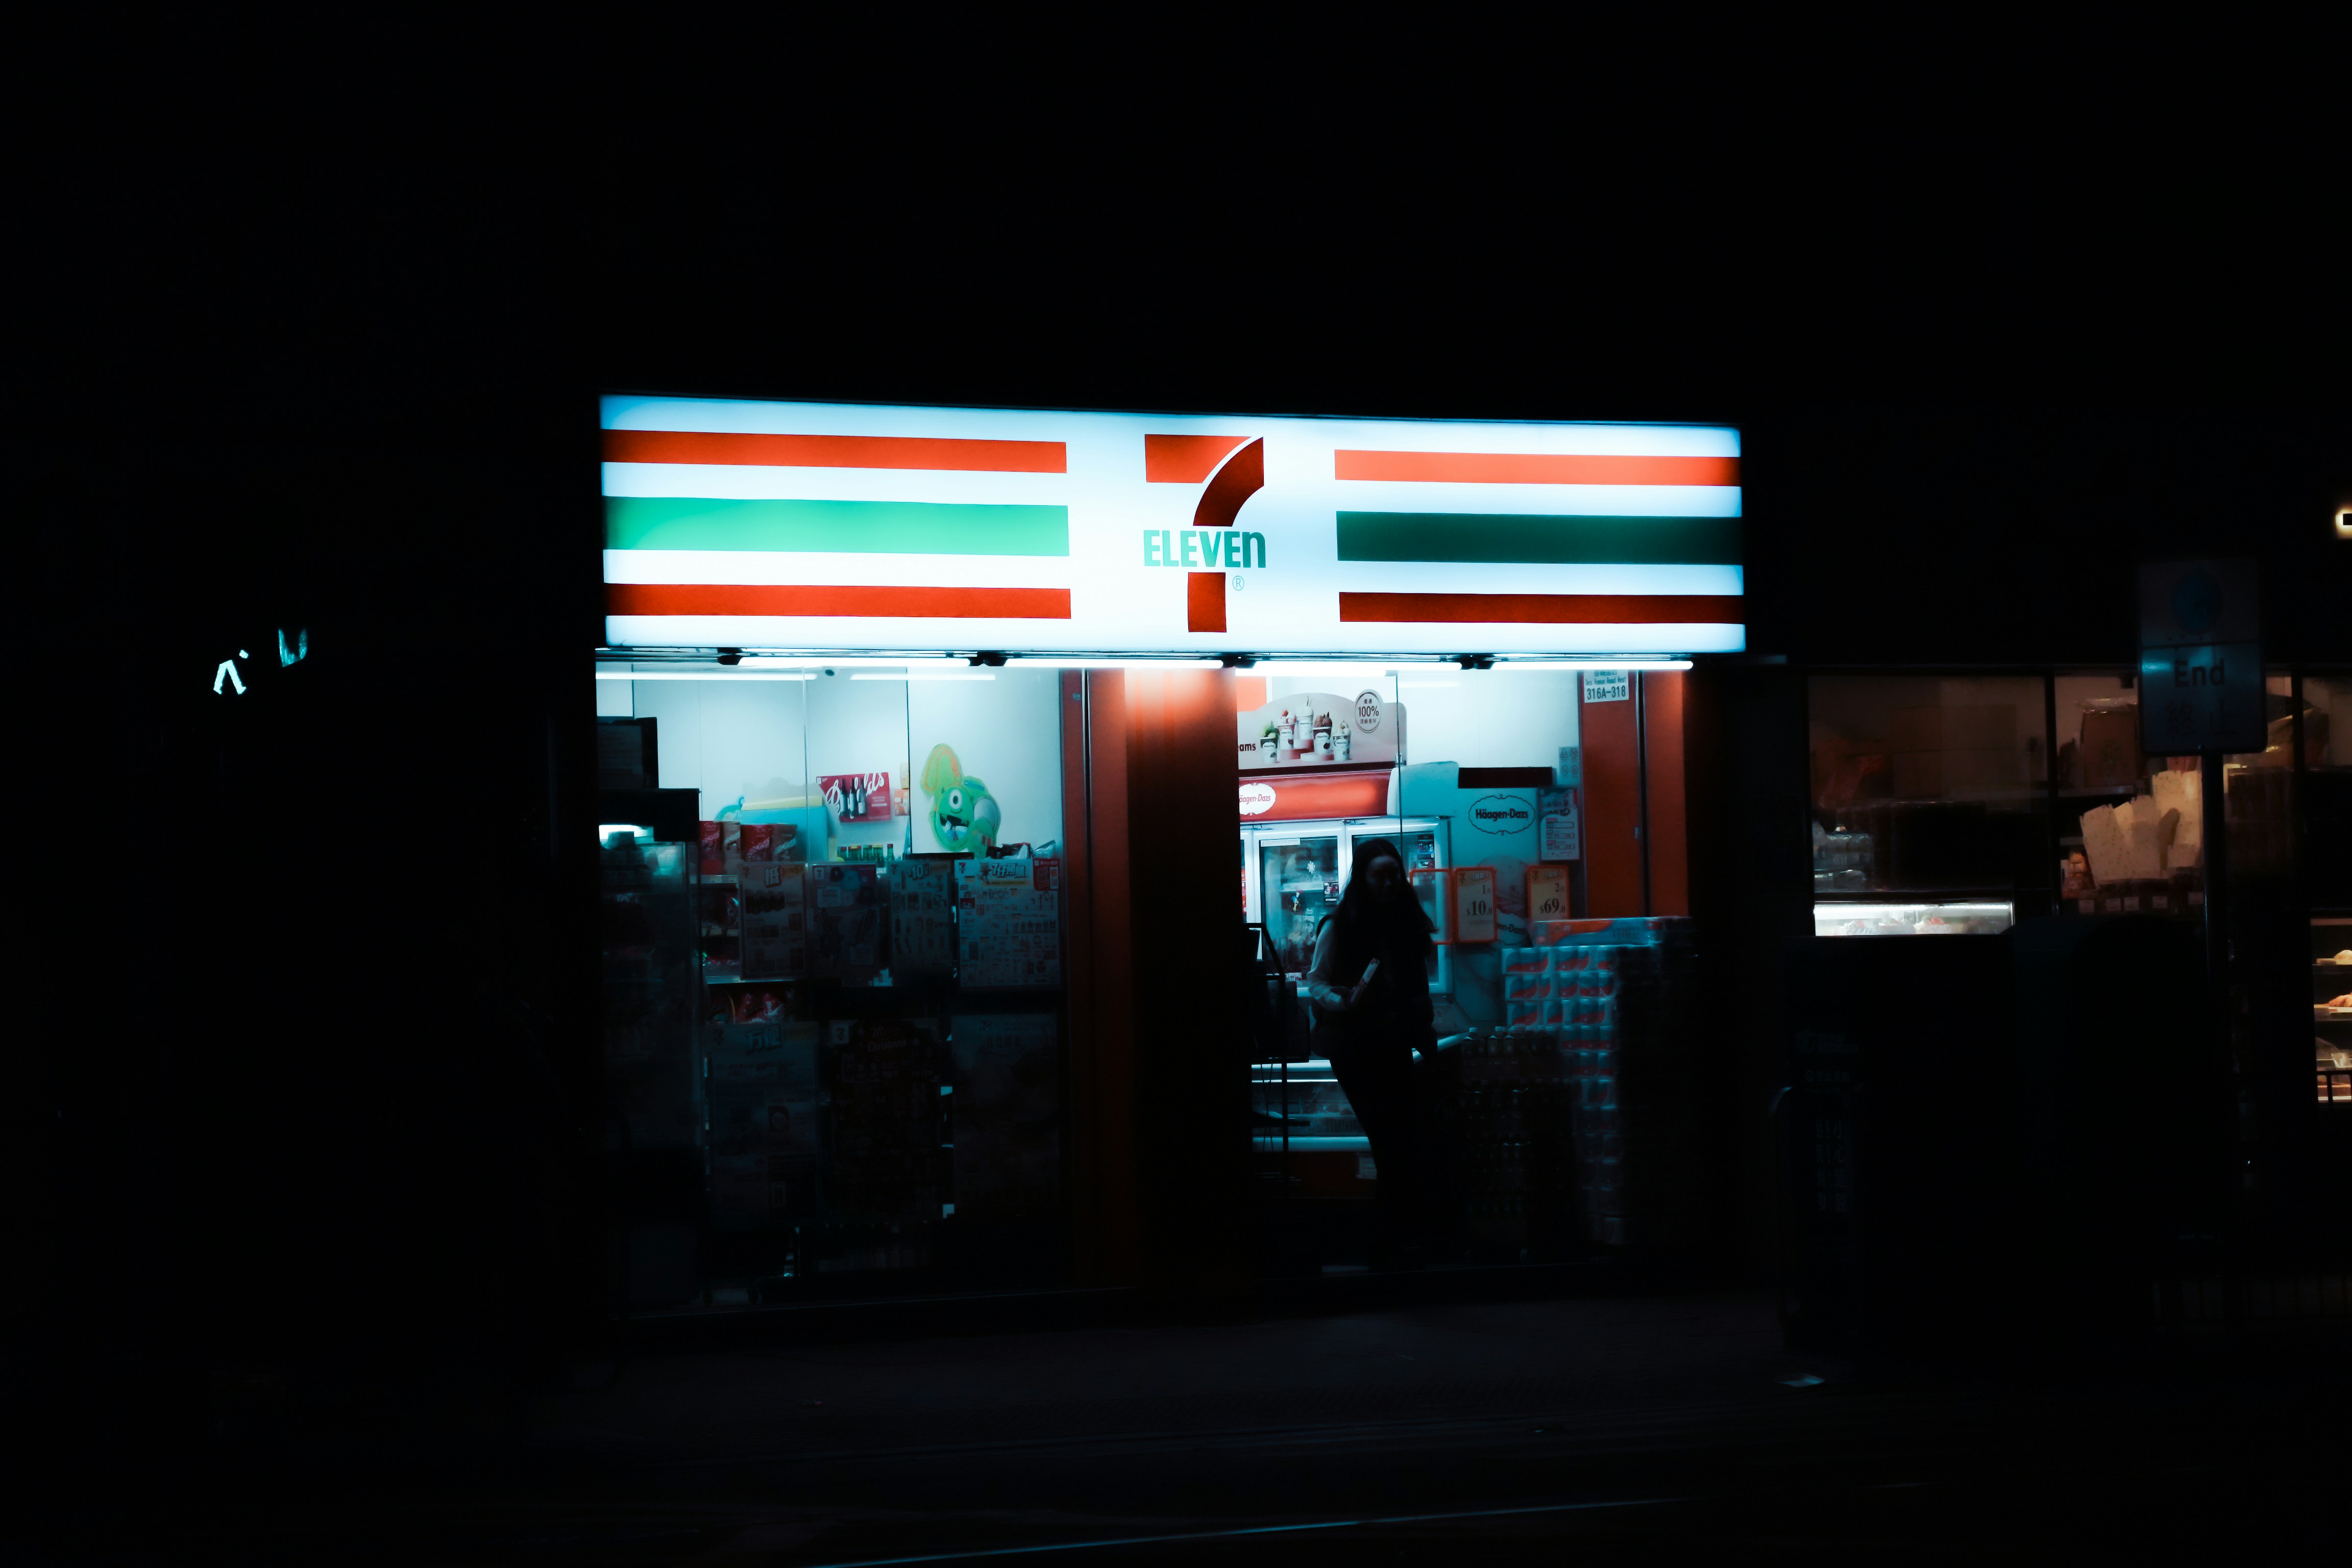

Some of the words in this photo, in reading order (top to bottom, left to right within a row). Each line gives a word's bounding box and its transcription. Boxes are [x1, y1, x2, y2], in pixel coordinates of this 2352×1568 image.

[1144, 434, 1264, 633] 7
[2174, 658, 2225, 687] End
[1587, 685, 1626, 700] 316A-318
[1358, 705, 1379, 717] 100%
[1238, 743, 1256, 751] ams
